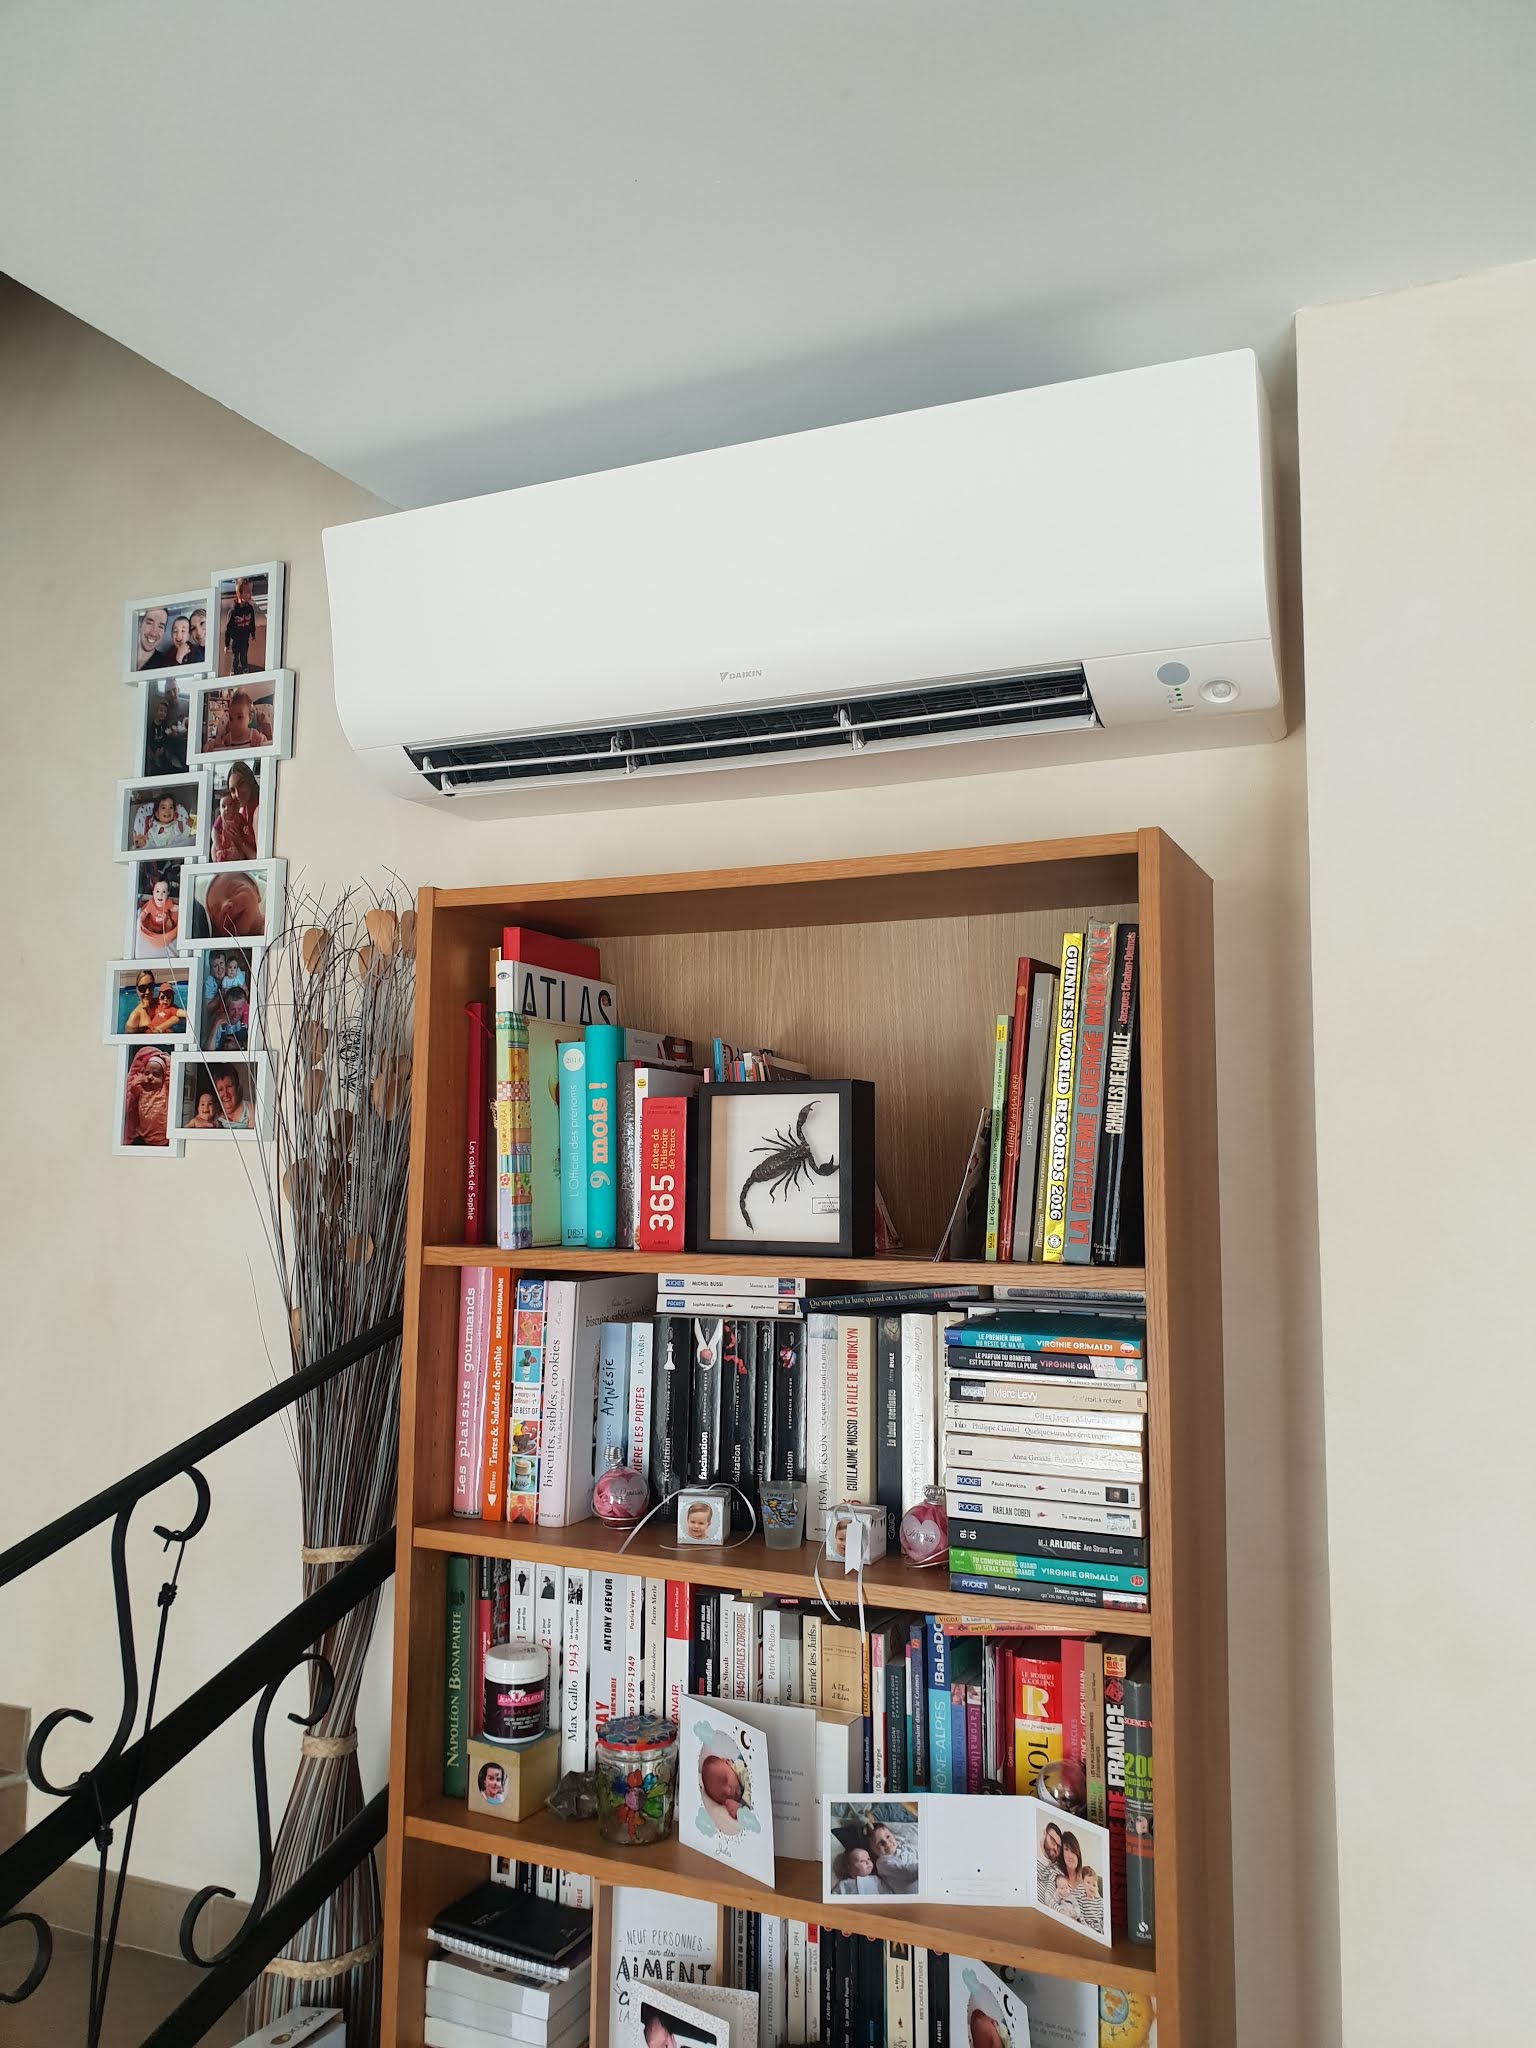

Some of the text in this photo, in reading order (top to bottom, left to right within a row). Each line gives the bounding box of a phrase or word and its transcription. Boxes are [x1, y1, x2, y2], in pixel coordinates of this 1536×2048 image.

[729, 670, 762, 679] DAIKIN
[1121, 931, 1136, 1025] Jacques Chaban-Delmas
[1049, 945, 1078, 1221] GUINNESS WORLD RECORDS 2016
[1069, 922, 1112, 1245] LA DEUXIEME GUERRE MONDIALE
[1105, 1032, 1131, 1134] CHARLES DE GAULLE
[588, 1082, 611, 1189] 9 mois !
[1025, 1096, 1035, 1146] pasta et risotto
[568, 1085, 580, 1197] L'Officiel des prénoms
[651, 1128, 660, 1170] dates de
[660, 1128, 668, 1170] l'Histoire
[668, 1128, 676, 1170] de France
[468, 1182, 475, 1190] de
[649, 1175, 675, 1231] 365
[467, 1192, 475, 1221] Sophie
[986, 1333, 1008, 1342] PREMIER
[1009, 1335, 1022, 1343] JOUR
[1036, 1340, 1113, 1351] VIRGINIE GRIMALDI
[493, 1346, 503, 1378] Sophie
[548, 1339, 561, 1387] cookies
[847, 1327, 858, 1417] LA FILLE DE BROOKLYN
[979, 1359, 991, 1367] PLUS
[1004, 1360, 1017, 1368] SOUS
[1017, 1361, 1024, 1369] LA
[1024, 1361, 1038, 1369] PLUIE
[982, 1353, 1001, 1361] PARFUM
[1009, 1354, 1031, 1362] BONHEUR
[1040, 1360, 1075, 1369] VIRGINIE
[457, 1288, 476, 1494] Les plaisirs gourmands
[492, 1379, 501, 1390] de
[993, 1388, 1038, 1401] Marc Levy
[491, 1392, 501, 1425] Salades
[545, 1390, 559, 1431] sablés,
[635, 1387, 645, 1422] PORTES
[491, 1427, 499, 1436] &
[634, 1426, 643, 1442] LES
[488, 1438, 499, 1466] Tartes
[543, 1435, 557, 1487] biscuits,
[662, 1438, 671, 1481] révélation
[698, 1431, 708, 1480] fascination
[847, 1419, 858, 1491] GUILLAUME MUSSO
[818, 1434, 829, 1511] LISA JACKSON
[957, 1476, 981, 1486] POCKET
[1006, 1481, 1026, 1489] Hawkins
[958, 1502, 983, 1513] POCKET
[993, 1506, 1031, 1518] HARLAN COBEN
[979, 1557, 1018, 1568] COMPRENDRAS
[1020, 1561, 1037, 1569] QUAND
[982, 1564, 1000, 1572] SERAS
[1000, 1566, 1014, 1574] PLUS
[1015, 1568, 1035, 1576] GRANDE
[1041, 1568, 1119, 1582] VIRGINIE GRIMALDI
[994, 1583, 1021, 1593] Marc Levy
[603, 1578, 613, 1652] ANTONY BEEVOR
[736, 1612, 746, 1698] 1945 CHARLES ZORGBIBE
[446, 1611, 462, 1767] NAPOLÉON BONAPARTE
[567, 1644, 580, 1742] Max Gallo 1943
[628, 1655, 636, 1703] 1939-1949
[1028, 1679, 1055, 1687] COLLINS
[1030, 1672, 1054, 1680] ROBERT
[931, 1701, 948, 1793] HÔNE-ALPES
[1105, 1702, 1125, 1788] FRANCE
[627, 1930, 702, 1951] NEUF PERSONNES
